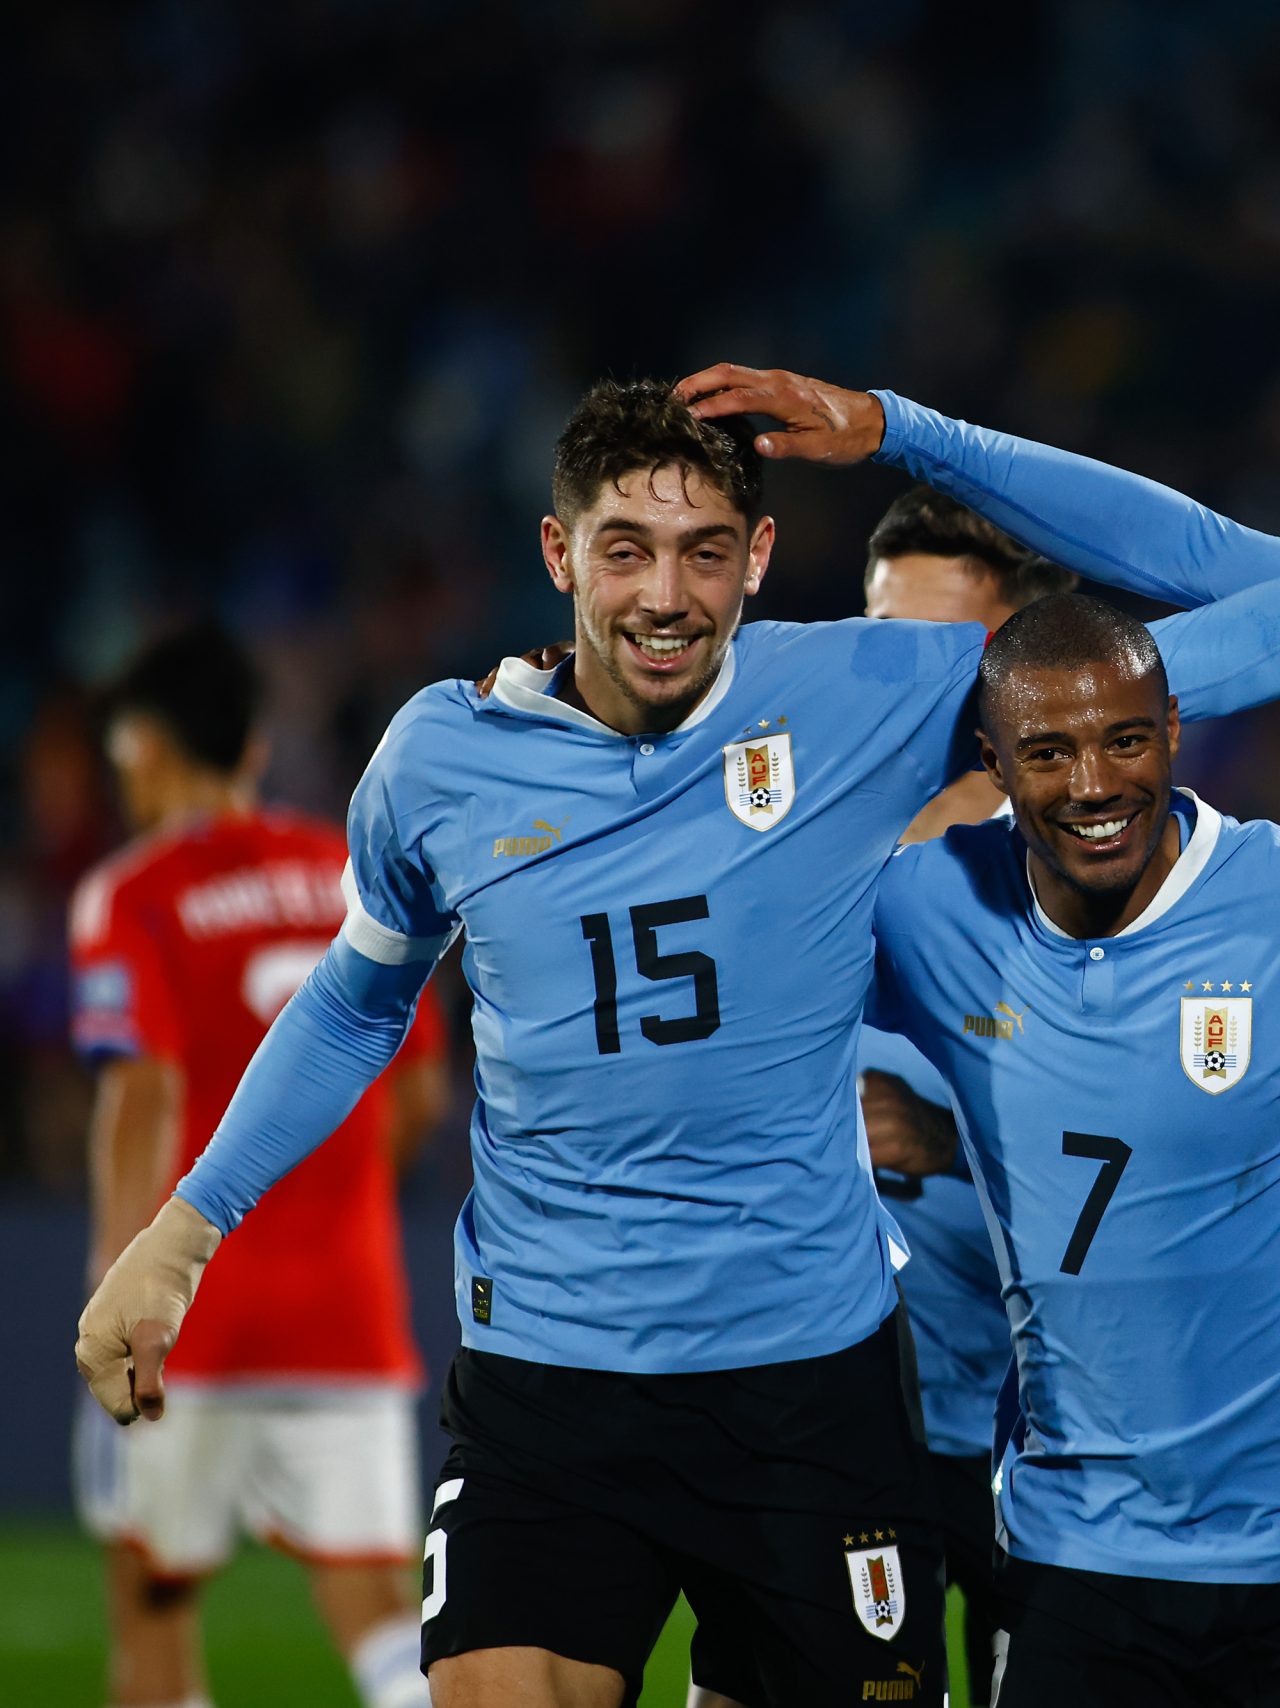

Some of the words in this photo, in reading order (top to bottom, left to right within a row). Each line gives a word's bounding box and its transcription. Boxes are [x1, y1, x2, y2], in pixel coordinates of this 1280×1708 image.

[751, 753, 767, 786] AUF
[580, 894, 721, 1055] 15
[963, 1015, 1014, 1040] PUMA
[1207, 1014, 1224, 1048] AUF
[1059, 1130, 1133, 1276] 7
[862, 1680, 914, 1701] PUMA
